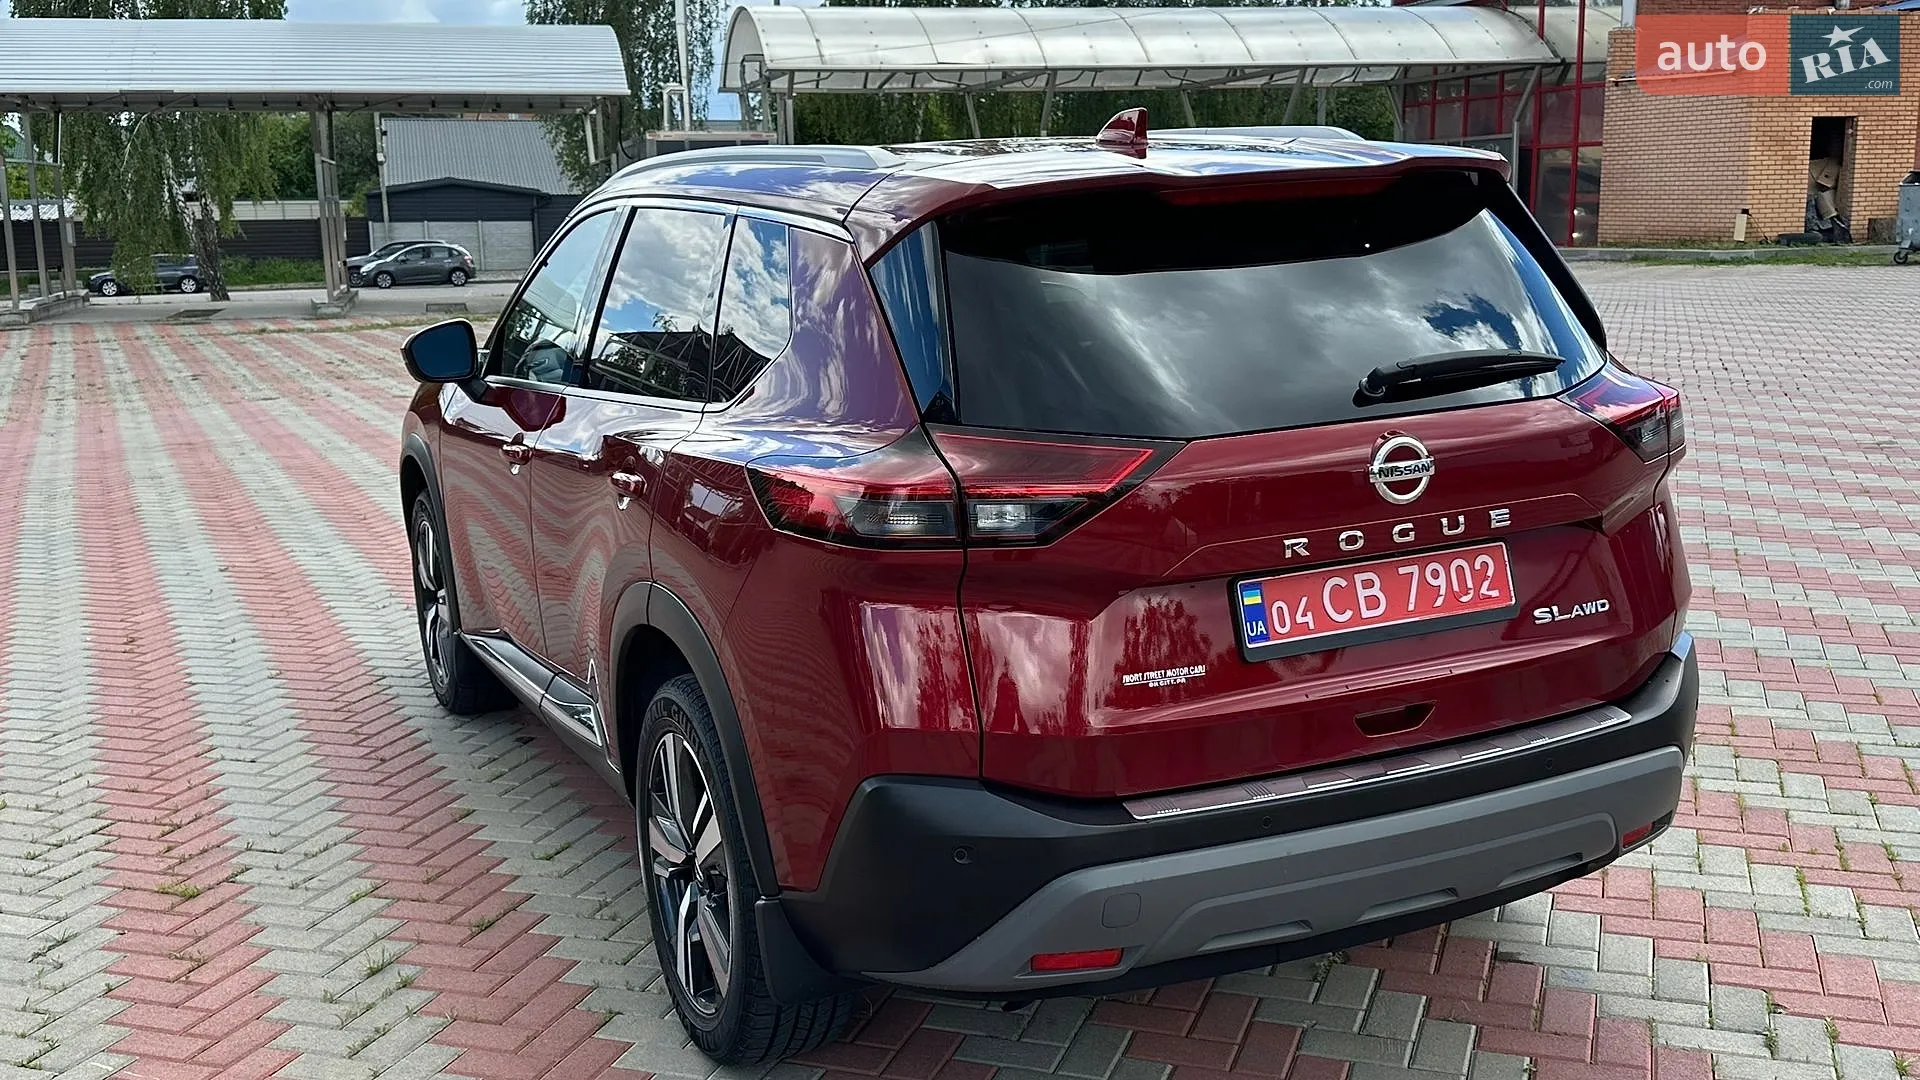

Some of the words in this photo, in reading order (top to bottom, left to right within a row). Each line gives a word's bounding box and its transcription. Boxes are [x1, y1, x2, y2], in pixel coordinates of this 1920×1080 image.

[1379, 463, 1430, 478] NISSAN
[1283, 508, 1511, 558] ROGUE
[1271, 595, 1315, 634] 04
[1322, 572, 1387, 623] CB
[1397, 554, 1500, 612] 7902
[1246, 620, 1267, 637] UA
[1143, 669, 1165, 680] STREET
[1166, 666, 1190, 677] MOTOR
